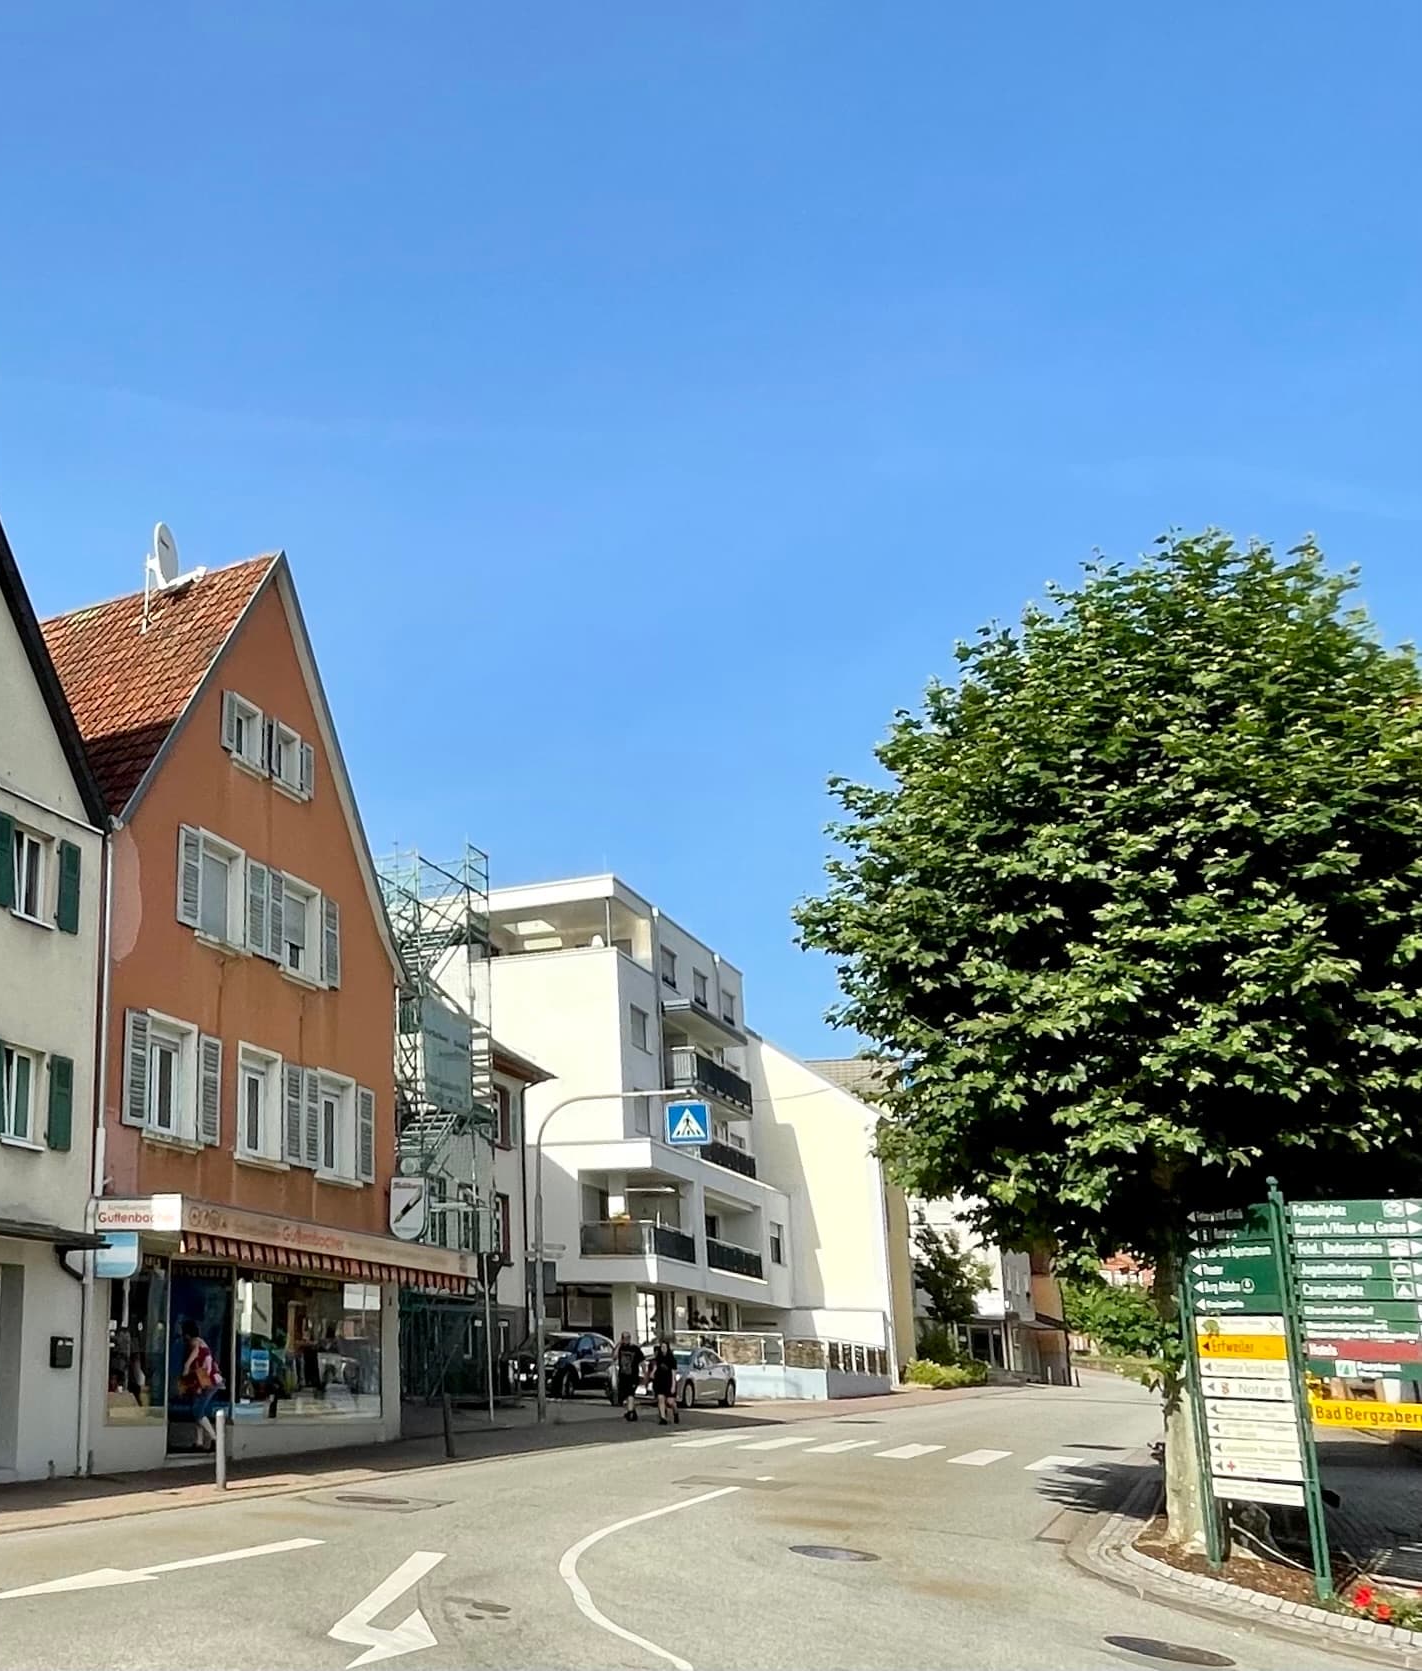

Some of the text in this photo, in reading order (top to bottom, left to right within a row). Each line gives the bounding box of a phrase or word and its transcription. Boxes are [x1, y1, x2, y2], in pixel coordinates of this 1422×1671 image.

[1211, 1340, 1254, 1352] Erfweiler
[1316, 1406, 1422, 1425] Bad Bergzaber
